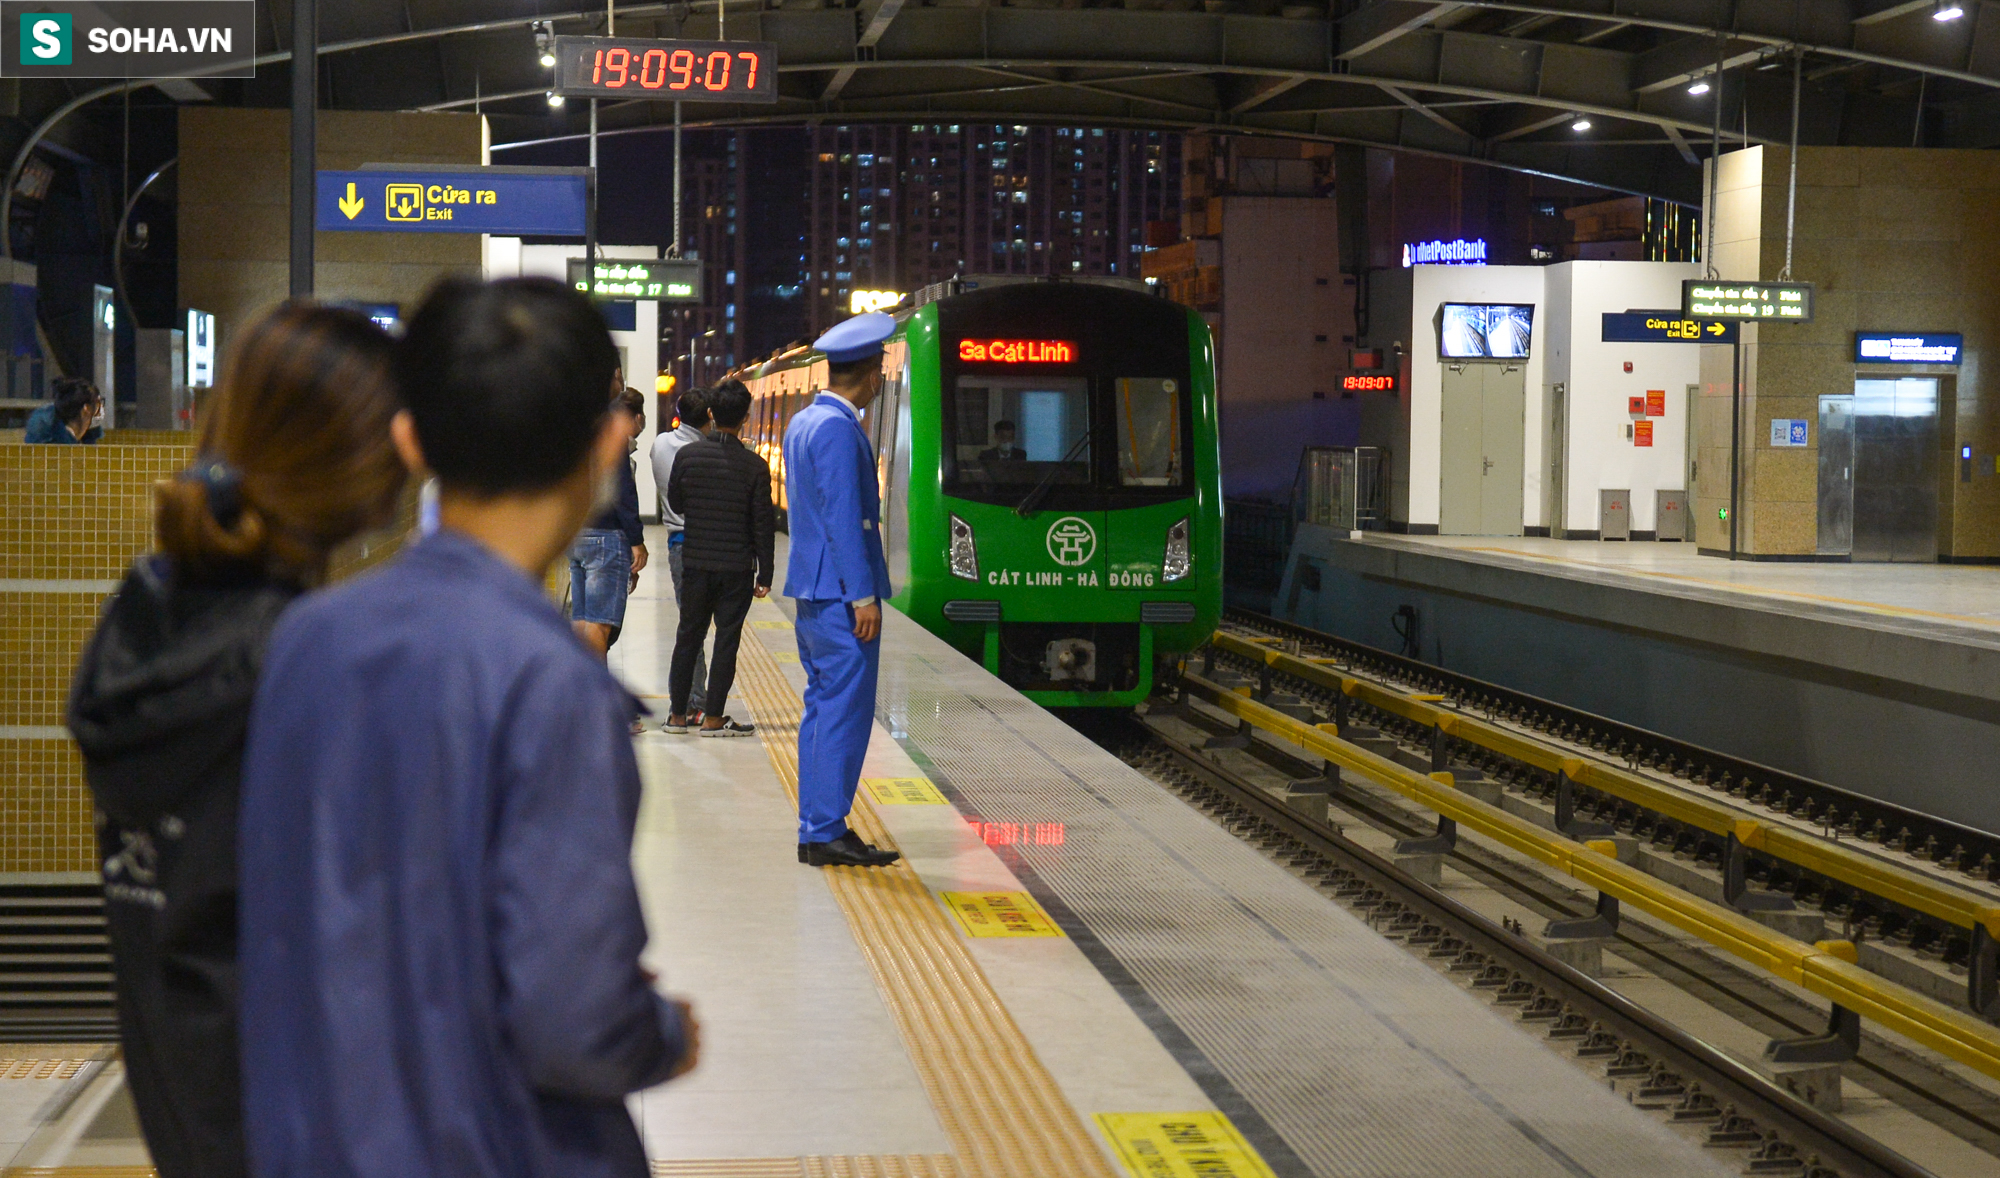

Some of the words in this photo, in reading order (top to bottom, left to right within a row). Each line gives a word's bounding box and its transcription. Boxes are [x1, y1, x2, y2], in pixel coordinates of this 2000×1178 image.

[592, 48, 758, 91] 19:09:07
[426, 185, 471, 204] Cửa
[476, 189, 497, 204] ra
[426, 208, 453, 220] Exit
[648, 283, 662, 296] 17
[1761, 290, 1769, 300] 4
[1762, 305, 1774, 316] 19
[1646, 319, 1668, 329] Cửa
[1669, 321, 1681, 330] ra
[1667, 330, 1681, 338] Exit
[959, 340, 985, 360] Ga
[989, 341, 1025, 362] Cát
[1028, 341, 1070, 361] Linh
[1343, 376, 1394, 389] 19:09:07
[988, 569, 1020, 586] CÁT
[1026, 573, 1063, 586] LINH
[1078, 570, 1099, 587] HÀ
[1109, 570, 1154, 587] ĐÔNG
